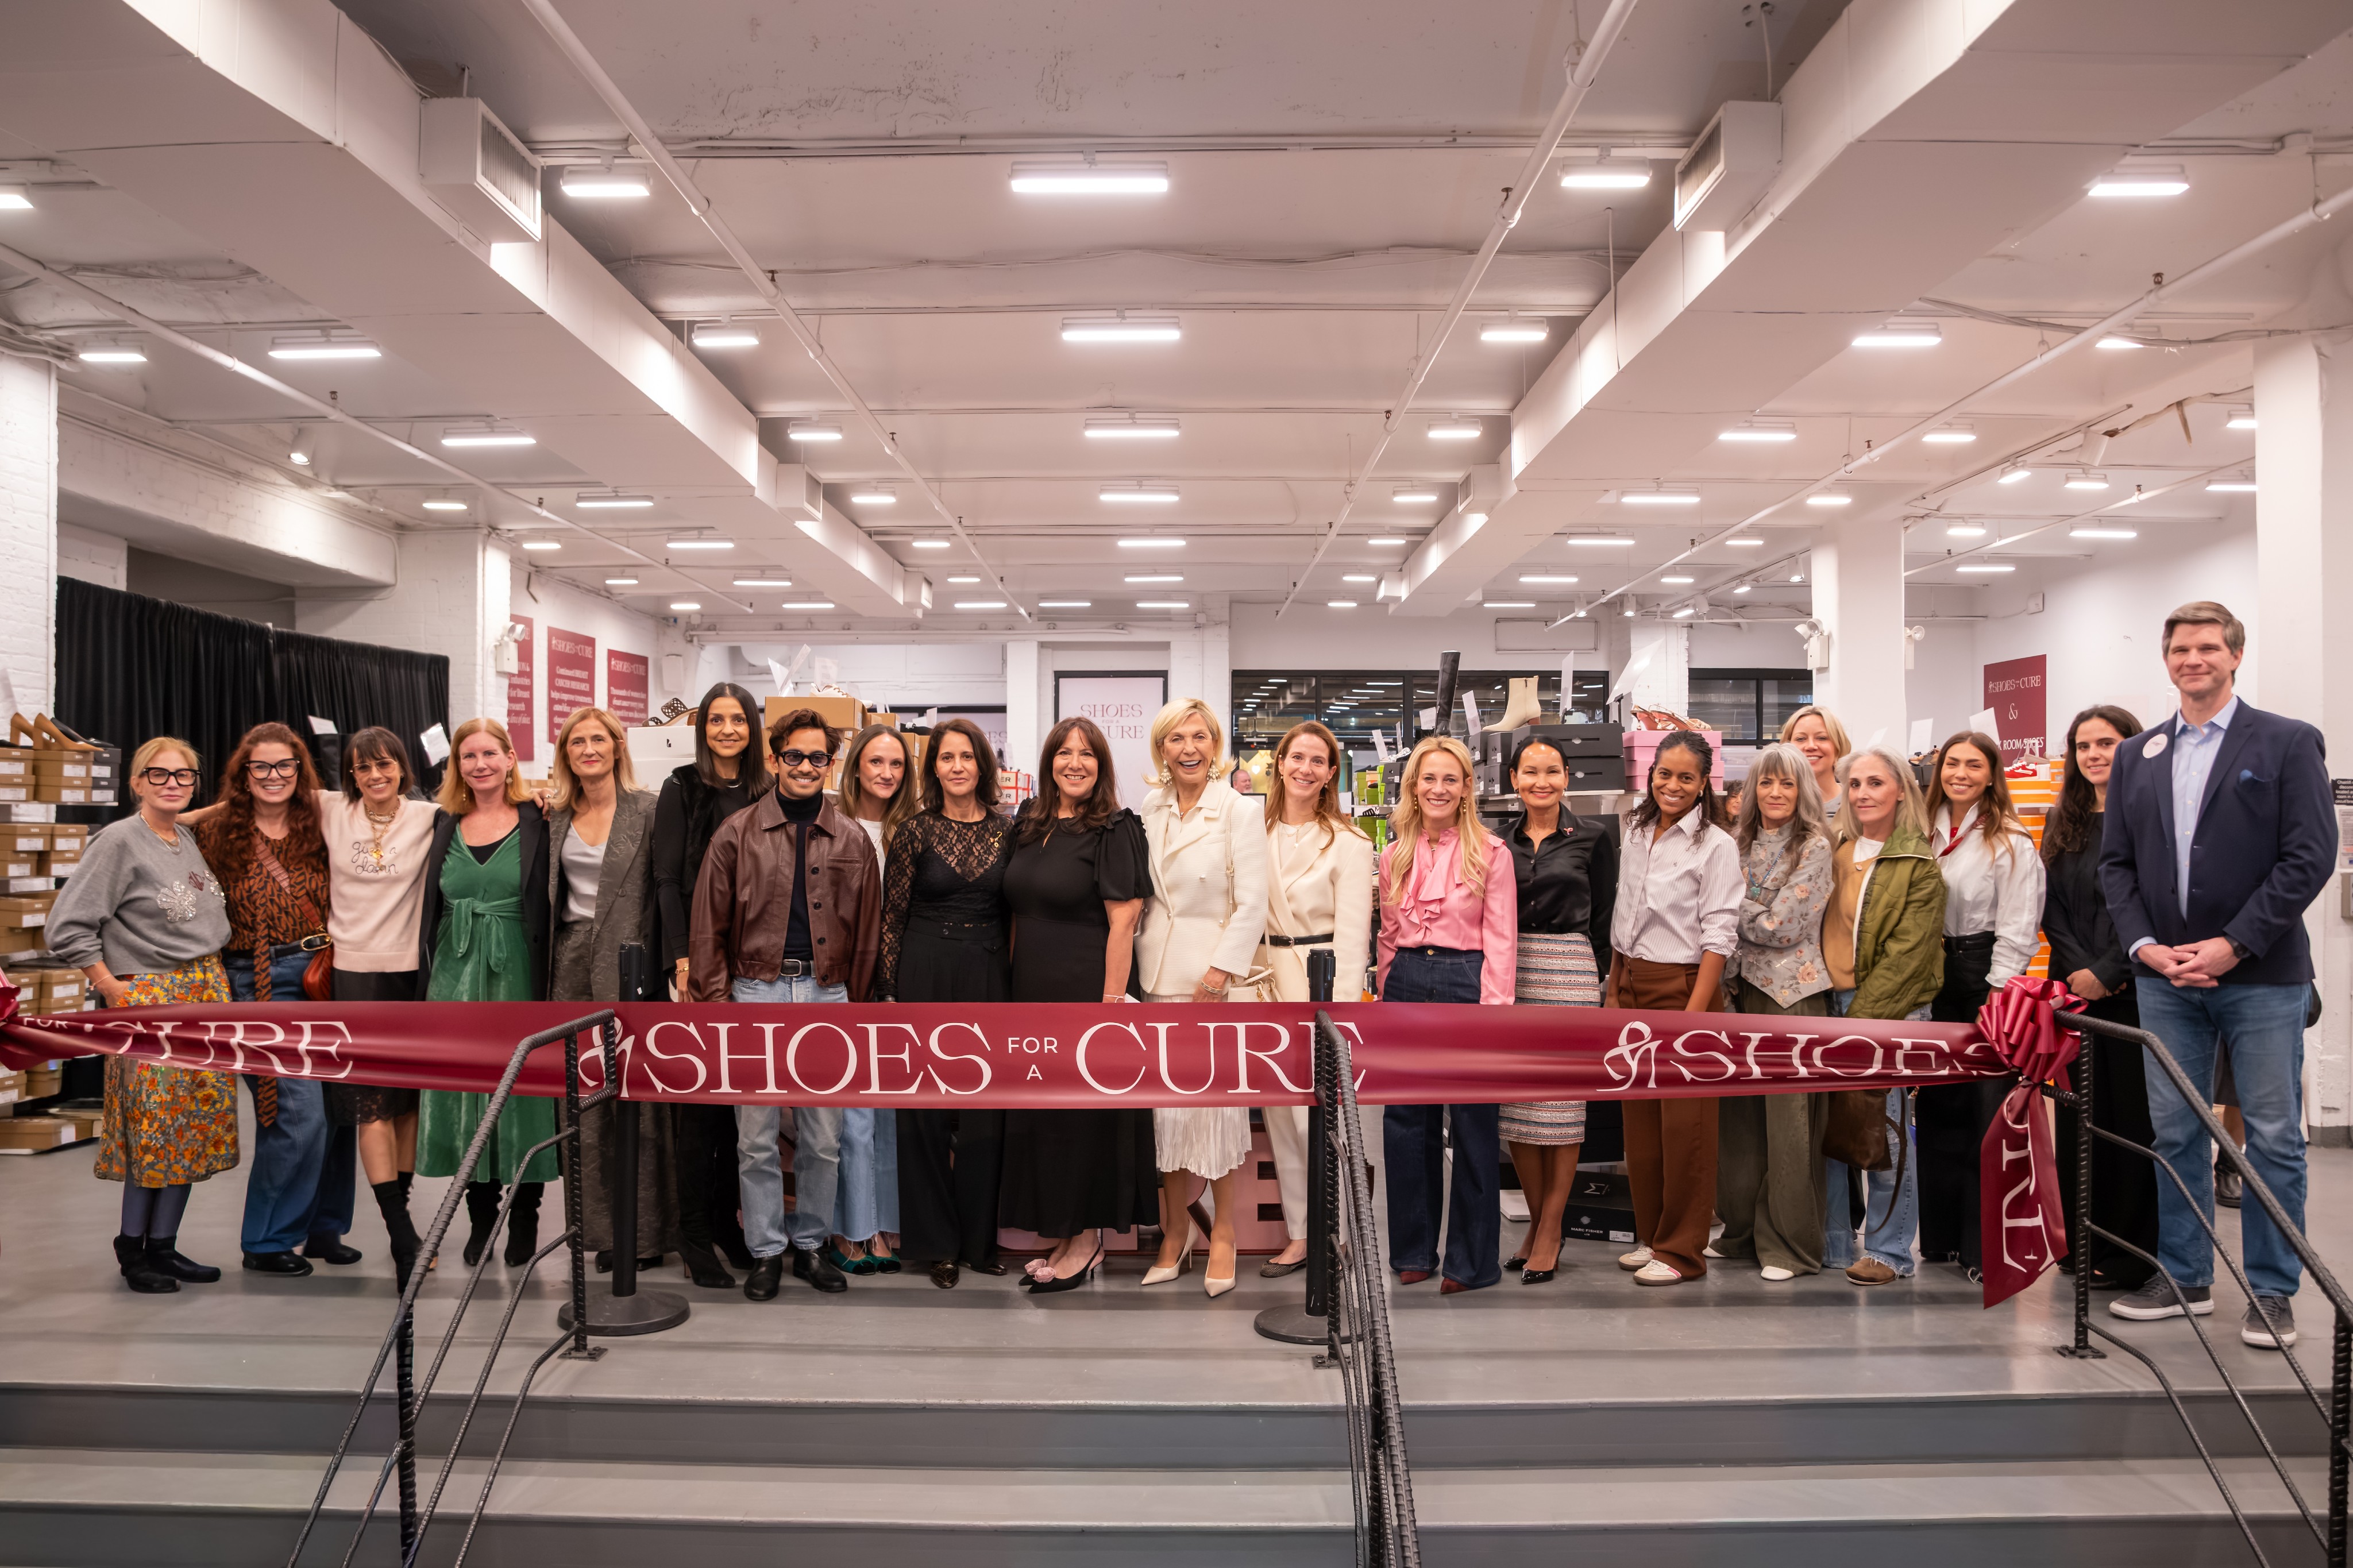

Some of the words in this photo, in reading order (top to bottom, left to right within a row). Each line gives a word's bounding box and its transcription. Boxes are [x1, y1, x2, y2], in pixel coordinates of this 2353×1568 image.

[1992, 679, 2015, 693] SHOES
[2020, 675, 2041, 689] CURE
[1081, 704, 1142, 717] SHOES
[2009, 703, 2018, 720] &
[1103, 725, 1144, 739] URE
[2003, 739, 2021, 750] ROOM
[352, 841, 372, 863] gi
[643, 1022, 992, 1094] SHOES
[1008, 1037, 1058, 1053] FOR
[1027, 1064, 1043, 1080] A
